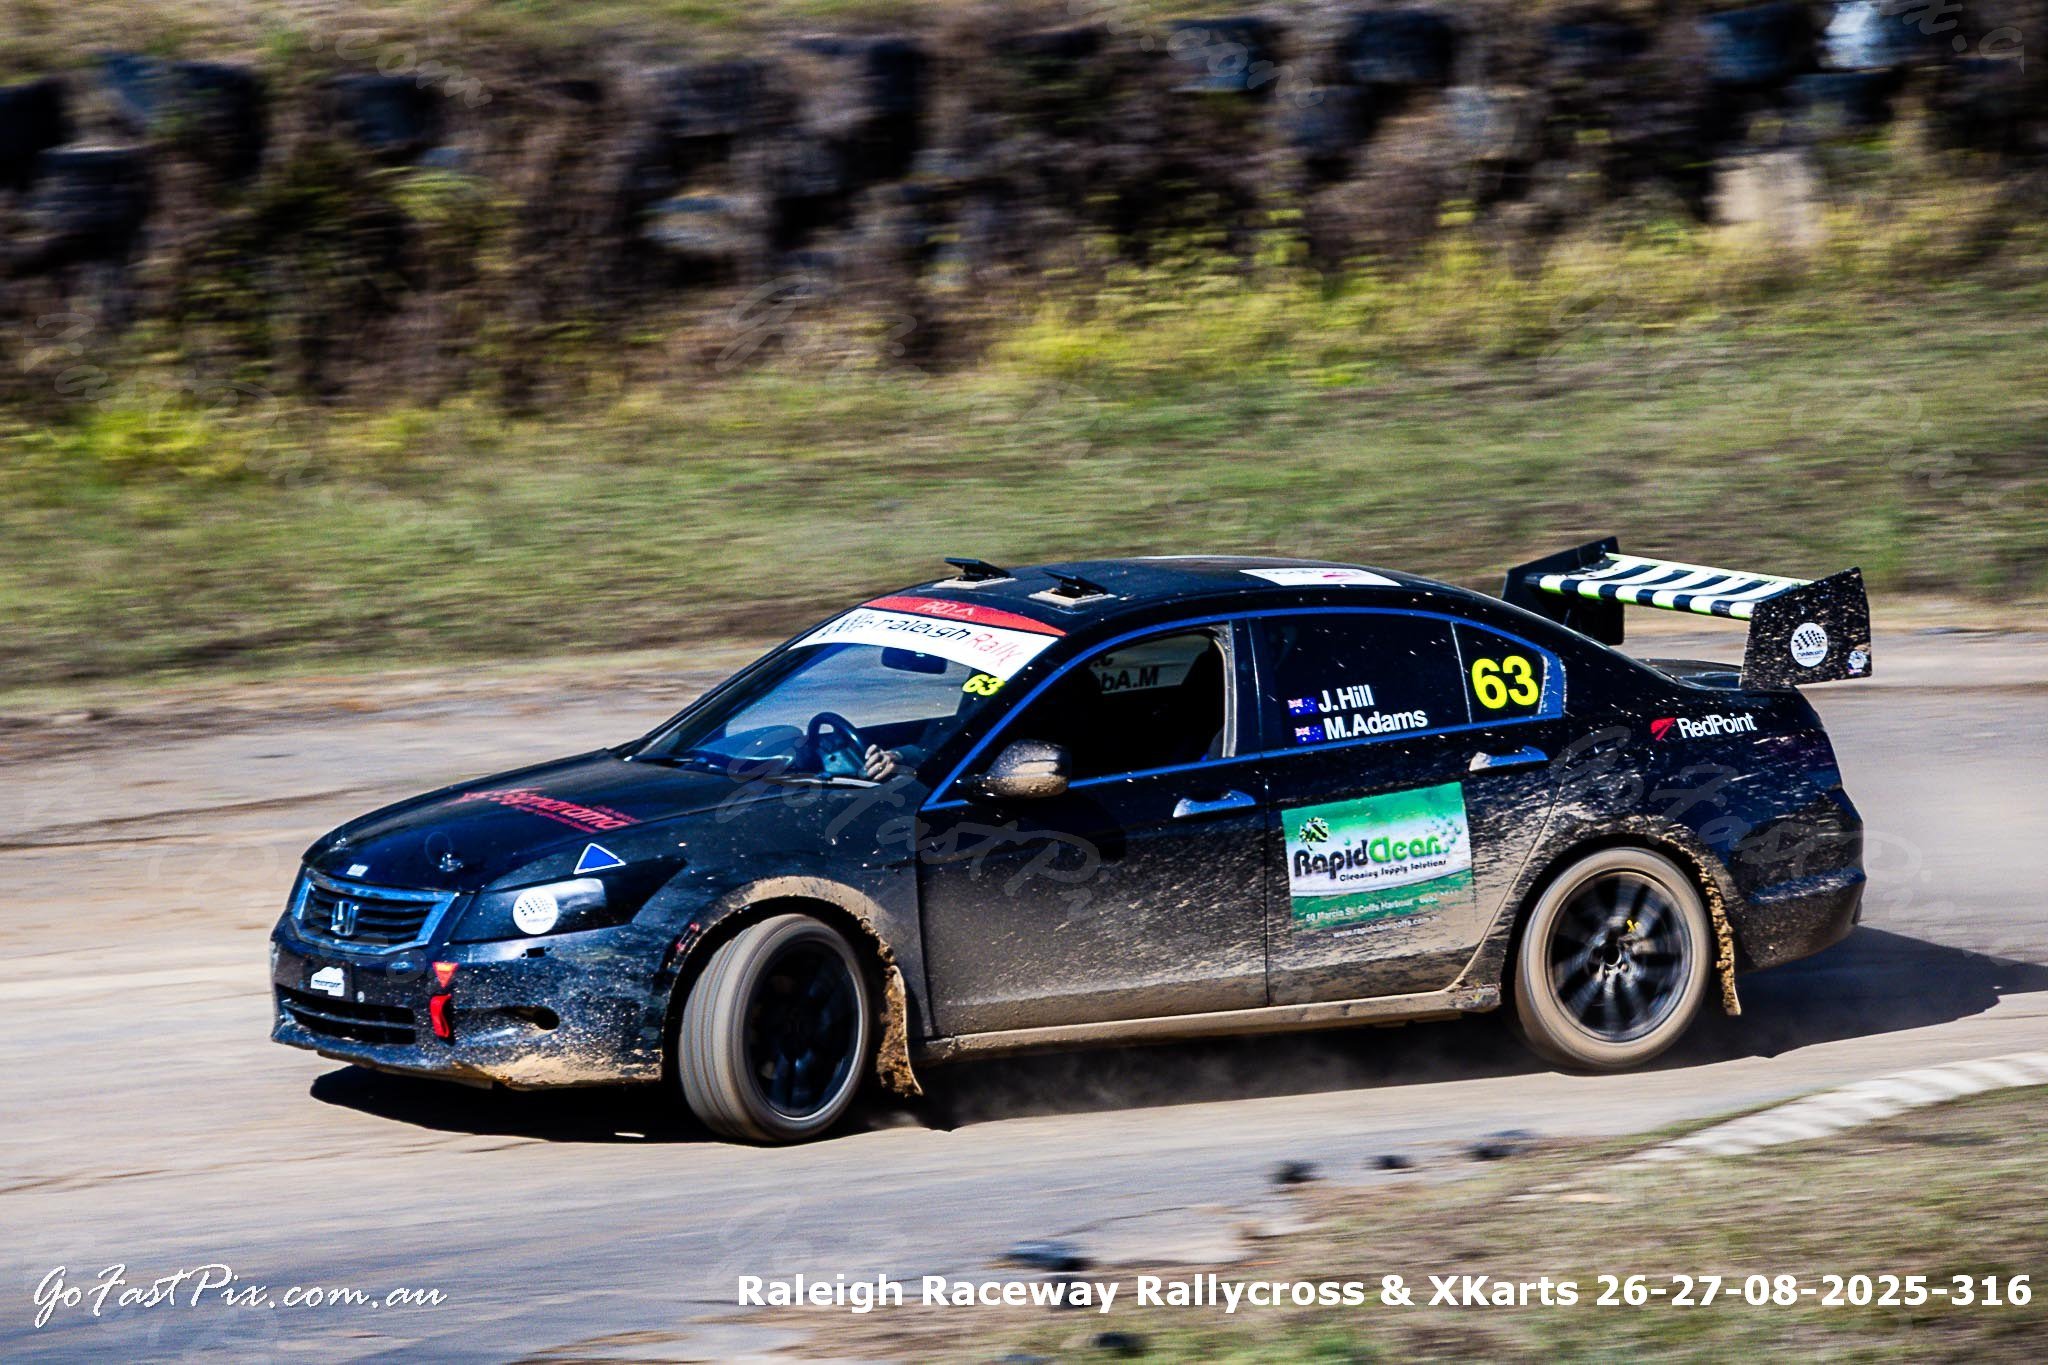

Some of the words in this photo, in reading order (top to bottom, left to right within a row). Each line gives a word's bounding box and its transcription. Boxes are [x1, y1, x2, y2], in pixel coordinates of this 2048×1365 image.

[873, 618, 972, 642] raleigh
[966, 632, 1023, 667] Rally
[962, 674, 1005, 696] 63
[1471, 655, 1539, 709] 63
[1317, 684, 1375, 713] J.Hill
[1322, 710, 1429, 740] M.Adams
[1676, 713, 1758, 739] RedPoint
[1293, 834, 1440, 881] RapidClean
[1340, 869, 1379, 882] Cleaning
[1381, 865, 1408, 877] Supply
[1410, 858, 1447, 871] Solutions
